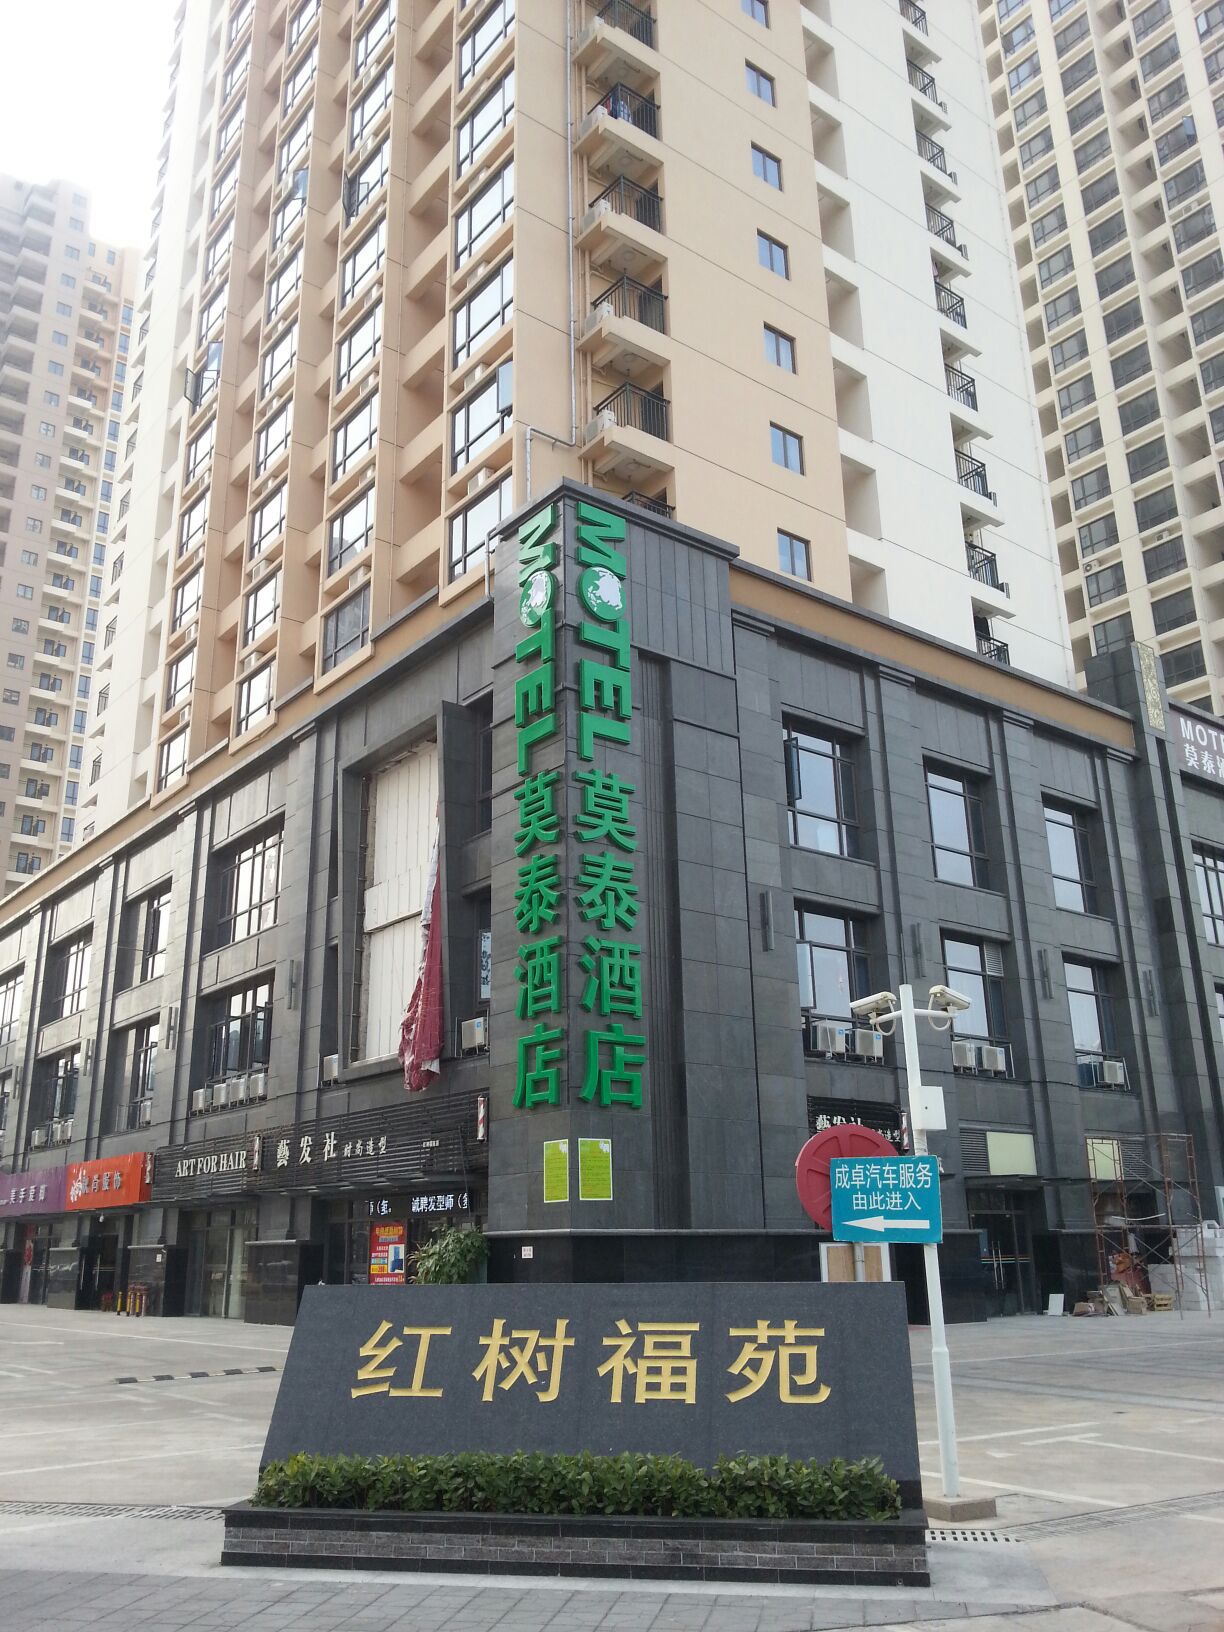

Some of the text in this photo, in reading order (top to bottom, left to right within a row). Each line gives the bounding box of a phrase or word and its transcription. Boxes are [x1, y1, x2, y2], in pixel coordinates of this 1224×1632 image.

[515, 502, 557, 776] MOTEL
[576, 500, 632, 762] MOTEL
[512, 769, 564, 1109] 莫泰酒店
[573, 769, 646, 1109] 莫泰酒店
[175, 1150, 247, 1178] ART FOR HAIR
[343, 1136, 388, 1157] 时尚造型
[835, 1162, 933, 1189] 成卓汽车服务
[852, 1191, 921, 1211] 由此进入
[350, 1317, 832, 1405] 红树福苑
